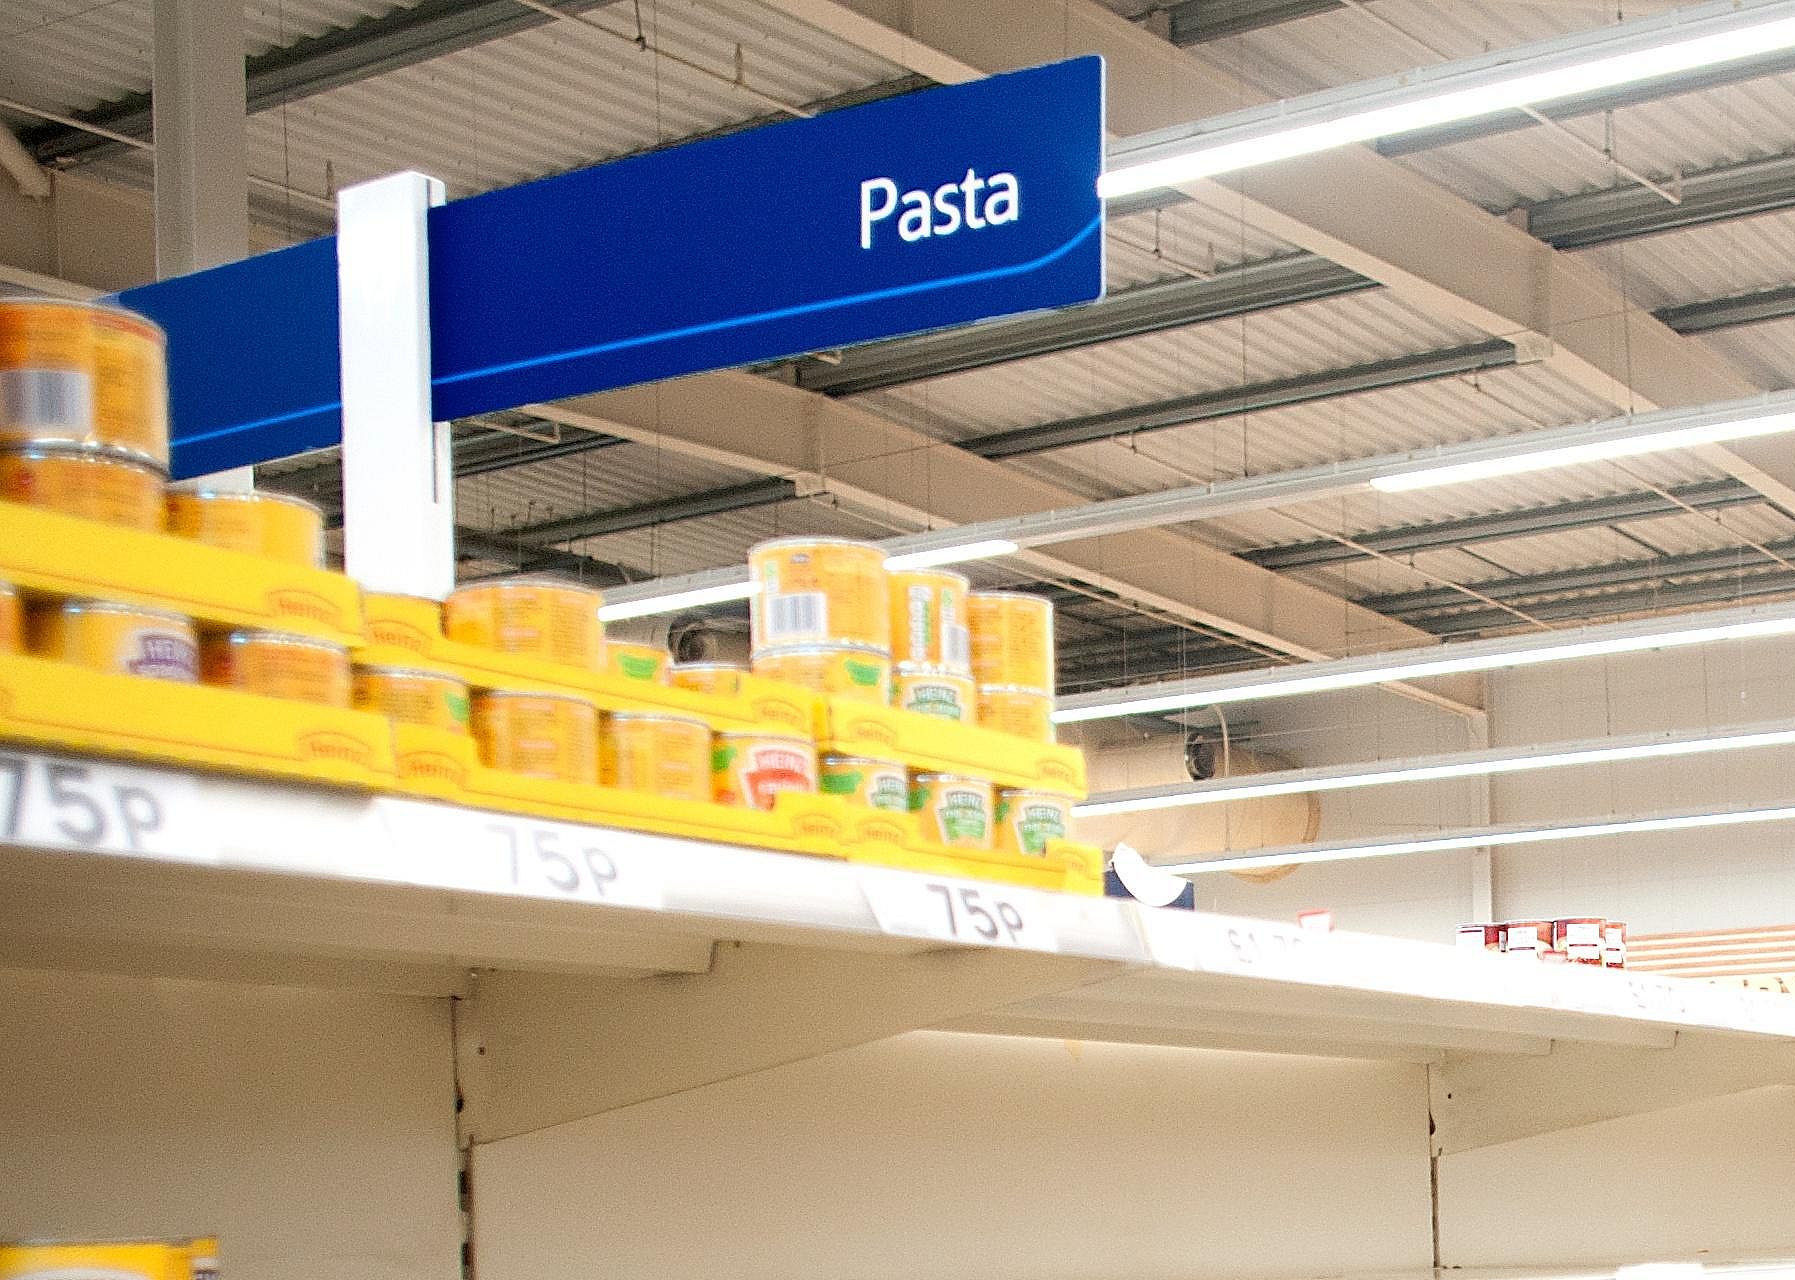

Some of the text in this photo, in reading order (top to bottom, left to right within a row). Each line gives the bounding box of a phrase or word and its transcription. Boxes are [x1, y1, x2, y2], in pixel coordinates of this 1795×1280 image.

[861, 168, 1019, 249] Pasta
[486, 823, 618, 897] 75p
[926, 884, 1024, 942] 75p
